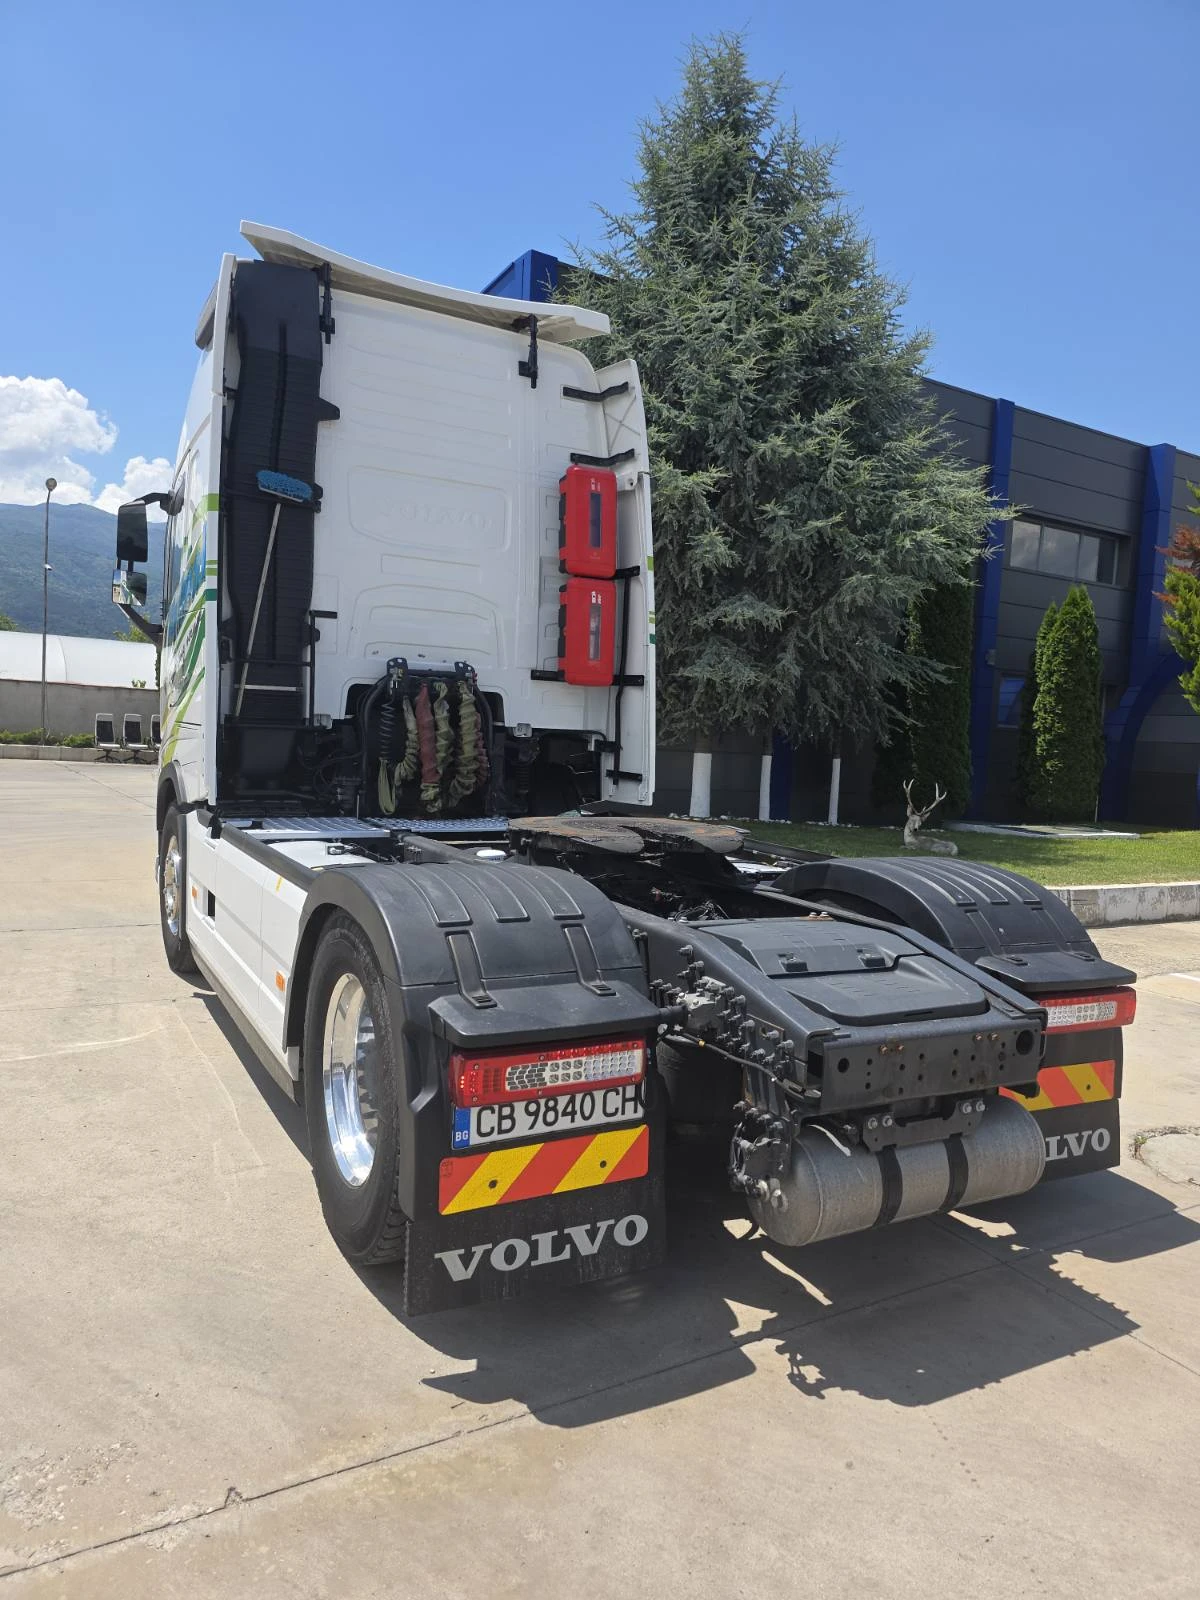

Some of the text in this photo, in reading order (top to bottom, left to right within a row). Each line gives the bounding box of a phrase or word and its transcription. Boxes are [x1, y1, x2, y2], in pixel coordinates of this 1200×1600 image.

[476, 1086, 639, 1138] CB 9840 CH
[455, 1131, 469, 1142] BG
[1046, 1128, 1111, 1161] LVO
[434, 1214, 649, 1282] VOLVO
